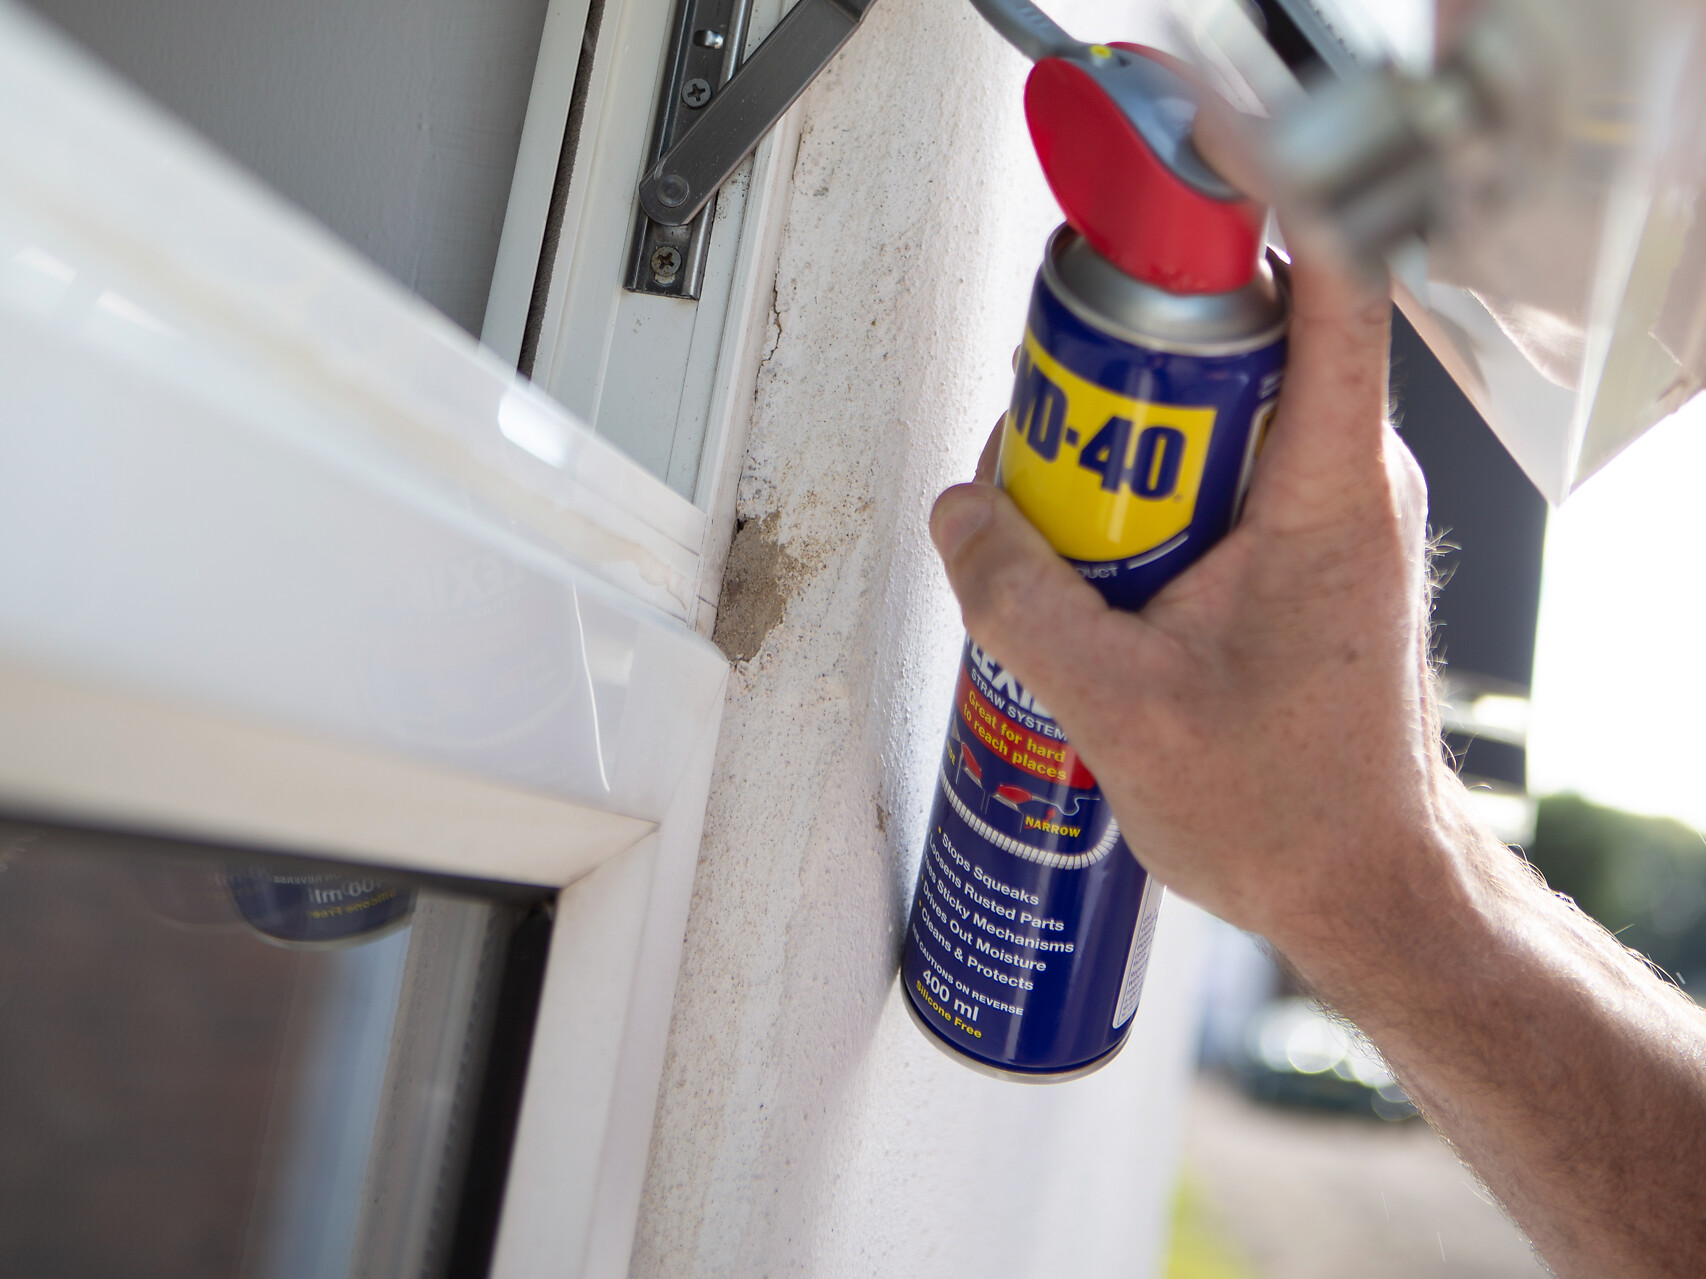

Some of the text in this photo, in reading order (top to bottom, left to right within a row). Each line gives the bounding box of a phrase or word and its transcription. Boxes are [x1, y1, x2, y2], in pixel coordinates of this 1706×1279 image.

[969, 690, 1066, 763] Great for hard
[971, 668, 1068, 741] STRAW SYSTEM
[963, 703, 972, 722] to
[974, 721, 1008, 756] reach
[1012, 752, 1067, 780] places
[1025, 816, 1081, 838] NARROW
[929, 832, 1065, 932] Loosens Rusted Parts
[942, 833, 1040, 906] Stops Squeaks
[921, 907, 952, 952] Cleans
[954, 947, 964, 963] &
[967, 956, 1034, 991] Protects
[923, 880, 948, 924] Drives
[949, 920, 973, 945] Out
[975, 938, 1047, 972] Moisture
[937, 879, 971, 920] Sticky
[973, 913, 1075, 953] Mechanisms
[916, 980, 982, 1038] Silicone Free
[919, 941, 1024, 1016] CAUTIONS ON REVERSE
[923, 970, 979, 1022] 400 ml
